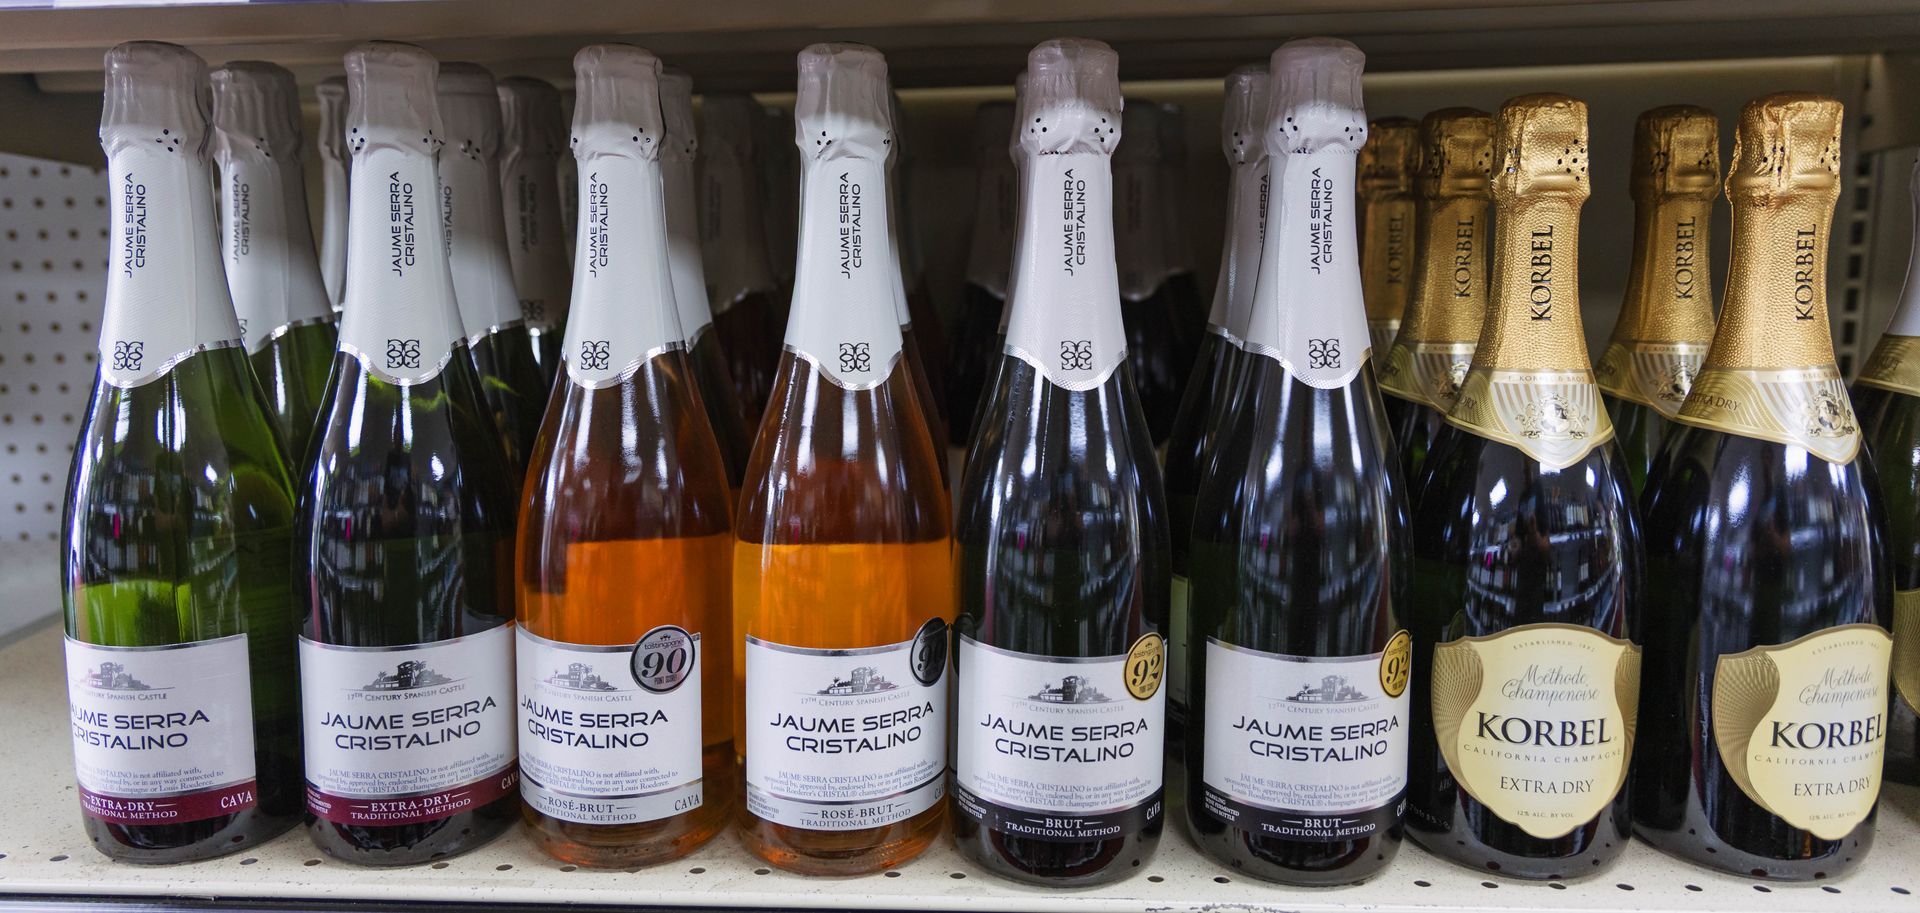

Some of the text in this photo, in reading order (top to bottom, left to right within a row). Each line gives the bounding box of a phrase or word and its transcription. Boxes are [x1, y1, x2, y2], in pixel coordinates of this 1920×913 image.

[124, 172, 134, 278] JAUME SERRA
[136, 184, 146, 268] CRISTALINO
[242, 184, 250, 256] CRISTALINO
[390, 171, 402, 276] JAUME SERRA
[403, 182, 414, 266] CRISTALINO
[588, 172, 598, 278] JAUME SERRA
[600, 183, 608, 267] CRISTALINO
[840, 172, 850, 279] JAUME SERRA
[852, 184, 862, 268] CRISTALINO
[1064, 168, 1074, 276] JAUME SERRA
[1076, 180, 1086, 266] CRISTALINO
[1310, 167, 1321, 274] JAUME SERRA
[1323, 178, 1333, 264] CRISTALINO
[1386, 213, 1406, 284] KORBEL
[1454, 216, 1474, 299] KORBEL
[1676, 216, 1696, 300] KORBEL
[1530, 224, 1553, 322] KORBEL
[1794, 224, 1816, 322] KORBEL
[1716, 397, 1742, 410] DRY
[642, 648, 687, 678] 90
[1132, 654, 1160, 686] 92
[1386, 651, 1408, 684] 92
[107, 693, 136, 701] SPANISH
[138, 693, 168, 701] CASTLE
[404, 690, 437, 700] SPANISH
[439, 684, 465, 694] CASTLE
[574, 694, 602, 702] SPANISH
[1502, 678, 1598, 707] Champenoise
[1799, 684, 1879, 711] Champenoise
[115, 710, 210, 730] SERRA
[320, 696, 496, 730] JAUME SERRA
[521, 694, 669, 728] JAUME SERRA
[771, 701, 934, 733] JAUME SERRA
[1287, 705, 1323, 714] CENTURY
[335, 720, 480, 750] CRISTALINO
[528, 718, 649, 749] CRISTALINO
[786, 726, 922, 754] CRISTALINO
[980, 714, 1148, 741] JAUME SERRA
[1232, 715, 1399, 741] JAUME SERRA
[1476, 712, 1612, 747] KORBEL
[1770, 713, 1884, 749] KORBEL
[995, 738, 1134, 763] CRISTALINO
[1249, 740, 1388, 762] CRISTALINO
[1463, 744, 1621, 764] CALIFORNIA CHAMPAGNE
[1754, 755, 1837, 766] CALIFORNIA
[379, 769, 429, 779] CRISTALINO
[829, 774, 877, 784] CRISTALINO
[1501, 776, 1594, 794] EXTRA DRY
[1794, 775, 1872, 797] EXTRA DRY
[82, 800, 177, 819] TRADITIONAL METHOD
[90, 796, 156, 811] EXTRA-DRY
[220, 790, 253, 808] CAVA
[351, 798, 471, 820] TRADITIONAL METHOD
[372, 792, 451, 812] EXTRA-DRY
[536, 801, 636, 821] TRADITIONAL METHOD
[549, 797, 615, 813] ROSÉ-BRUT
[674, 794, 700, 811] CAVA
[822, 804, 894, 819] ROSÉ-BRUT
[800, 808, 911, 827] TRADITIONAL METHOD
[1006, 821, 1120, 837] TRADITIONAL METHOD
[1046, 818, 1083, 829] BRUT
[1262, 822, 1376, 837] TRADITIONAL METHOD
[1304, 818, 1341, 828] BRUT
